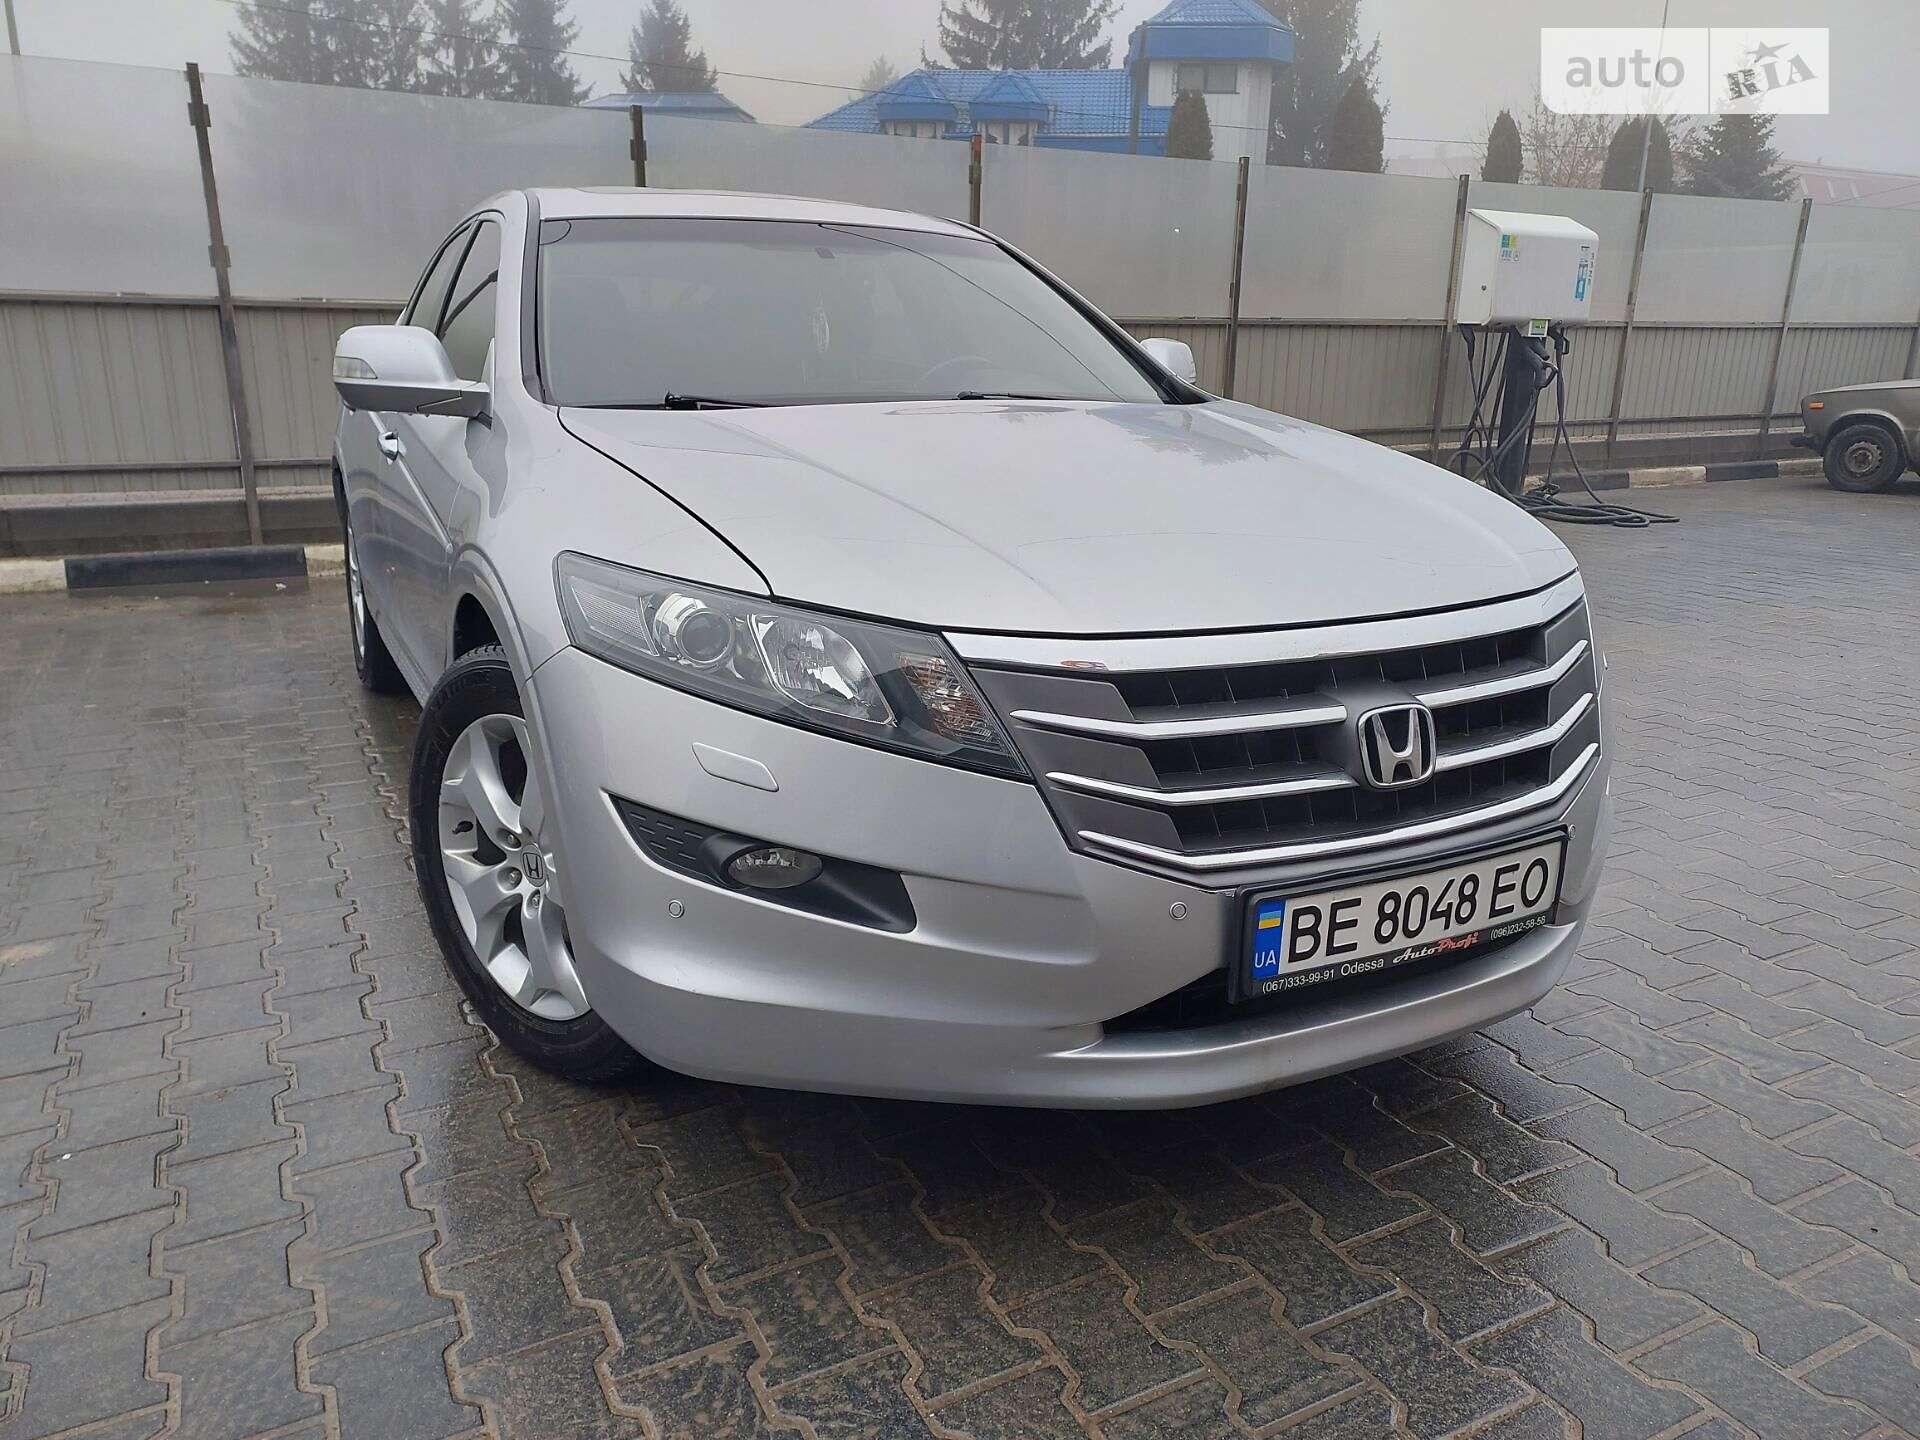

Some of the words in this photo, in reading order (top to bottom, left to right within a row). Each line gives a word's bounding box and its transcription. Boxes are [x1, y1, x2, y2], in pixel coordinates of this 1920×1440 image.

[1288, 897, 1362, 964] BE
[1374, 873, 1480, 944] 8048
[1488, 857, 1549, 919] EO
[1254, 949, 1277, 968] UA
[1262, 968, 1335, 993] (067)333-99-91
[1340, 958, 1384, 976] Odessa
[1490, 915, 1546, 940] (096)232-58-58
